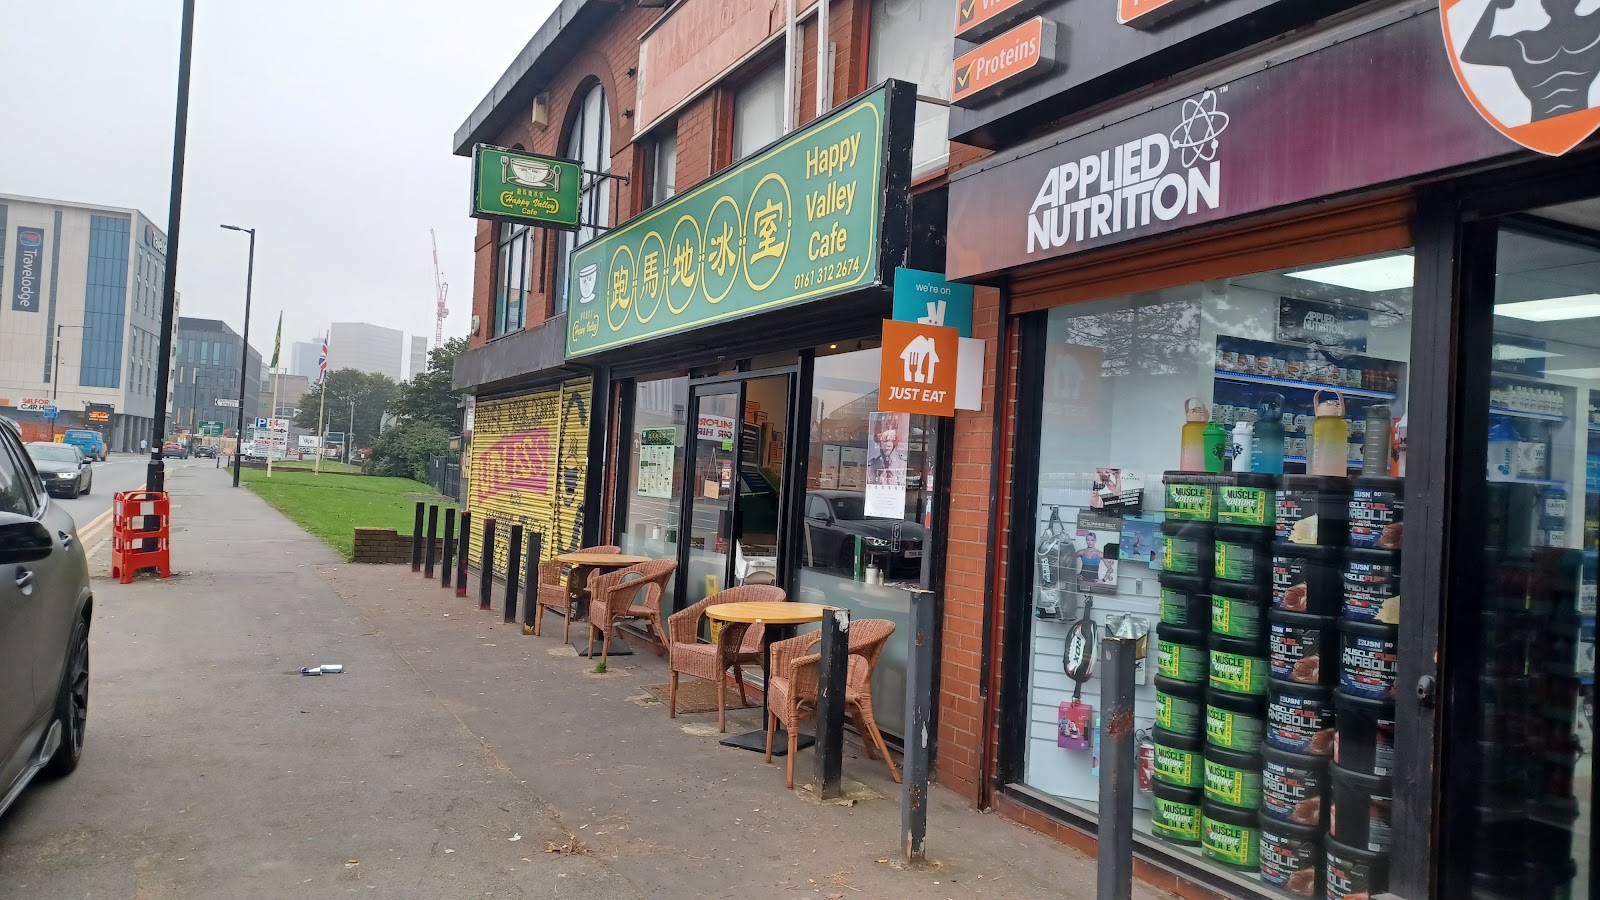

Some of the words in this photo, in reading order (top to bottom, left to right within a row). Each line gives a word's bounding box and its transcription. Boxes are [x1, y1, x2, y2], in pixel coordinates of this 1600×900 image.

[976, 36, 1036, 81] Proteins
[806, 131, 861, 179] Happy
[1029, 132, 1170, 214] APPLIED
[505, 194, 530, 207] Happy
[532, 199, 555, 211] Valley
[806, 180, 857, 222] Valley
[1027, 160, 1220, 253] NUTRITION
[521, 207, 538, 216] Cafe
[808, 221, 847, 262] Cafe
[610, 199, 786, 312] 跑馬地冰室
[20, 248, 38, 307] Travelodge
[794, 269, 815, 290] 0161
[816, 264, 834, 283] 312
[835, 257, 860, 279] 2674
[915, 282, 939, 294] we're
[940, 286, 951, 295] on
[1304, 310, 1335, 323] APPLIED
[1303, 320, 1344, 334] NUTRITION
[888, 386, 920, 401] JUST
[921, 389, 947, 403] EAT
[1175, 487, 1205, 497] MUSCLE
[1227, 489, 1258, 500] MUSCLE
[1349, 508, 1394, 522] NABOLIC
[1355, 563, 1370, 571] USN
[1344, 582, 1393, 596] NABOLIC
[1073, 636, 1083, 663] RDX
[1365, 640, 1381, 648] USN
[1215, 654, 1243, 668] MUSCLE
[1285, 697, 1300, 705] USN
[1268, 708, 1322, 729] ANABOLIC
[1158, 747, 1184, 761] MUSCLE
[1208, 765, 1234, 780] MUSCLE
[1163, 802, 1194, 817] MUSCLE
[1210, 822, 1241, 837] MUSCLE
